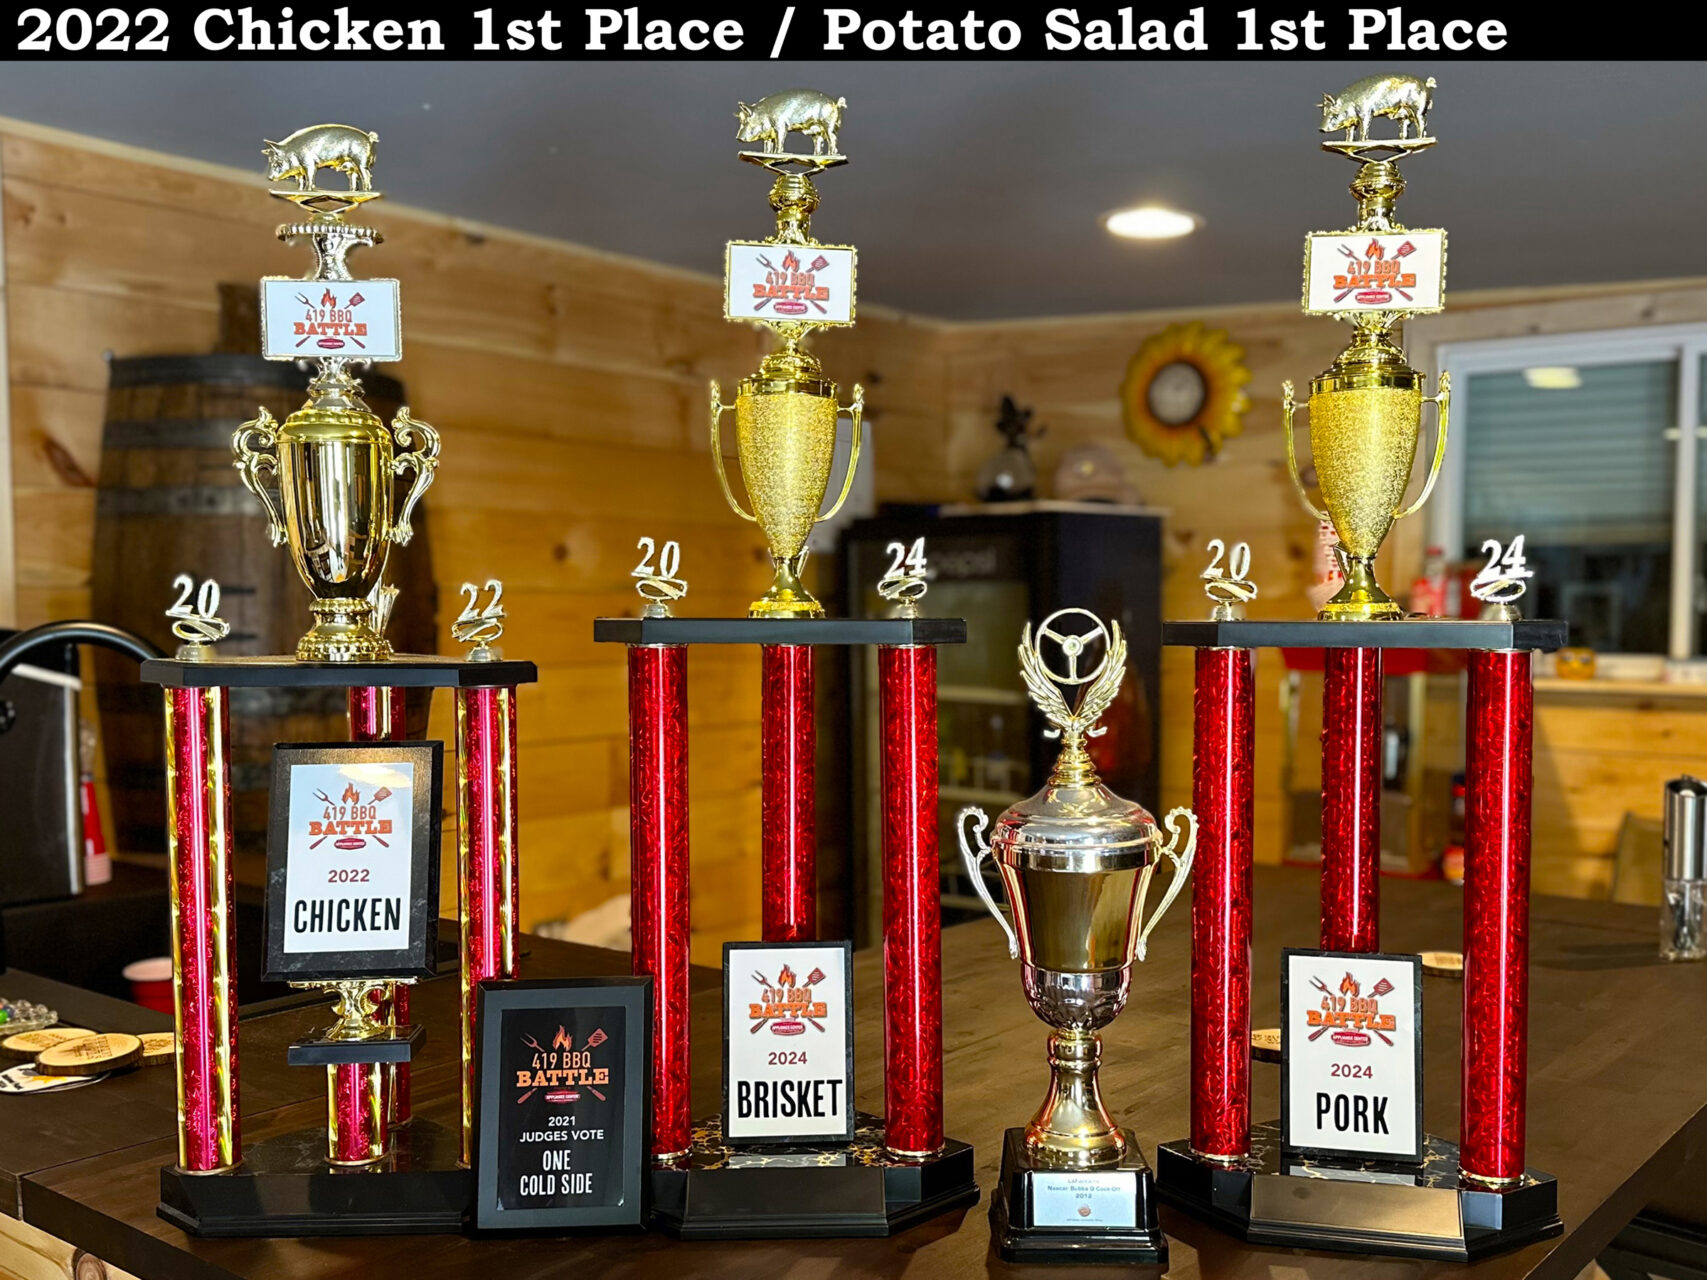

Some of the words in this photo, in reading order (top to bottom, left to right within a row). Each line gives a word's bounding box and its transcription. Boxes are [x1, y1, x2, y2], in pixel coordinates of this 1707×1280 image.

[1333, 273, 1416, 290] BATTLE
[752, 283, 830, 301] BATTLE
[305, 309, 326, 322] 419
[329, 309, 353, 323] BBQ
[293, 322, 368, 337] BATTLE
[631, 536, 682, 580] 20
[885, 536, 928, 579] 24
[1200, 538, 1251, 581] 20
[1478, 534, 1528, 579] 24
[166, 574, 221, 619] 20
[459, 579, 506, 621] 22
[323, 806, 347, 821] 419
[350, 805, 377, 820] BBQ
[309, 820, 392, 836] BATTLE
[328, 869, 370, 883] 2022
[293, 897, 401, 933] CHICKEN
[749, 1002, 827, 1019] BATTLE
[1306, 1010, 1396, 1032] BATTLE
[532, 1052, 557, 1069] 419
[562, 1051, 591, 1068] BBQ
[768, 1051, 808, 1065] 2024
[516, 1068, 609, 1087] BATTLE
[1330, 1063, 1373, 1079] 2024
[737, 1079, 843, 1118] BRISKET
[548, 1116, 576, 1127] 2021
[1316, 1092, 1390, 1135] PORK
[519, 1131, 568, 1142] JUDGES
[571, 1130, 604, 1140] VOTE
[542, 1149, 571, 1171] ONE
[520, 1174, 555, 1196] COLD
[561, 1173, 593, 1194] SIDE
